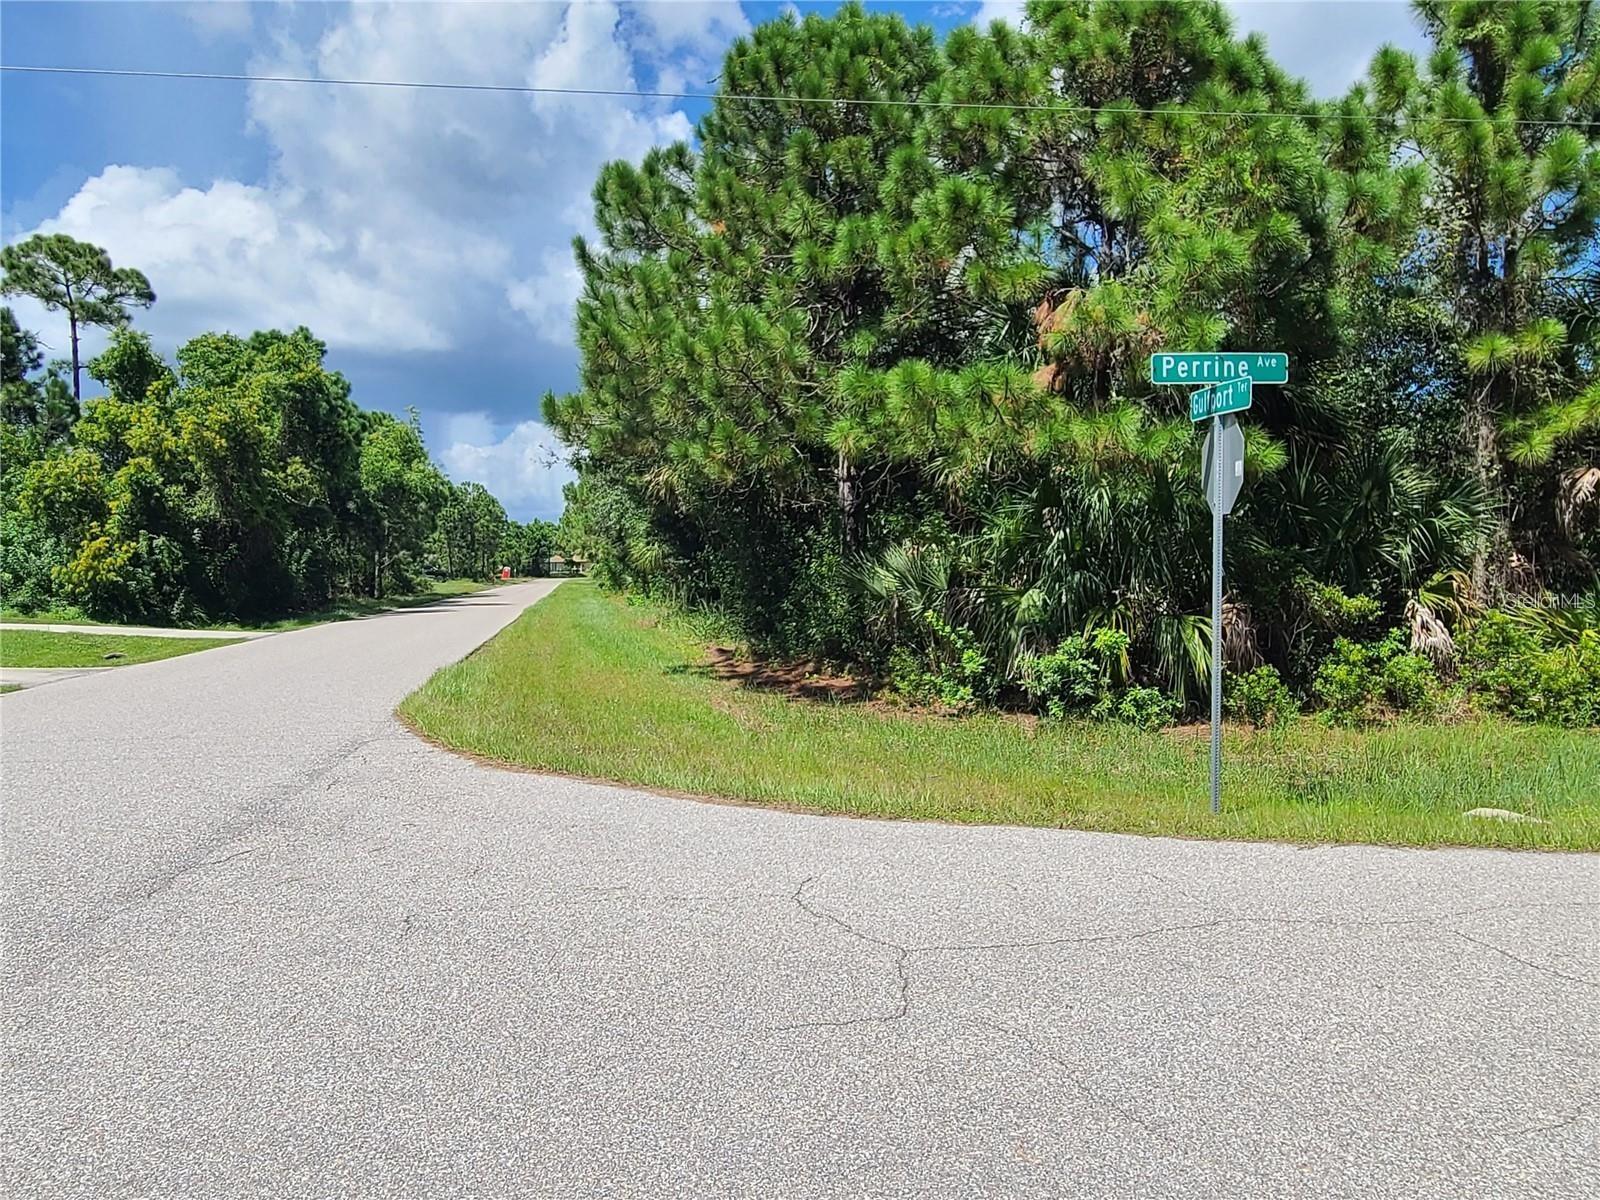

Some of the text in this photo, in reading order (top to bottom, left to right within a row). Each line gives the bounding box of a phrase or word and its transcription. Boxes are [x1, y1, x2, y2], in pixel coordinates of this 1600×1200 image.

[1162, 356, 1277, 378] Perrine Ave
[1192, 381, 1248, 415] Gulfport Ter
